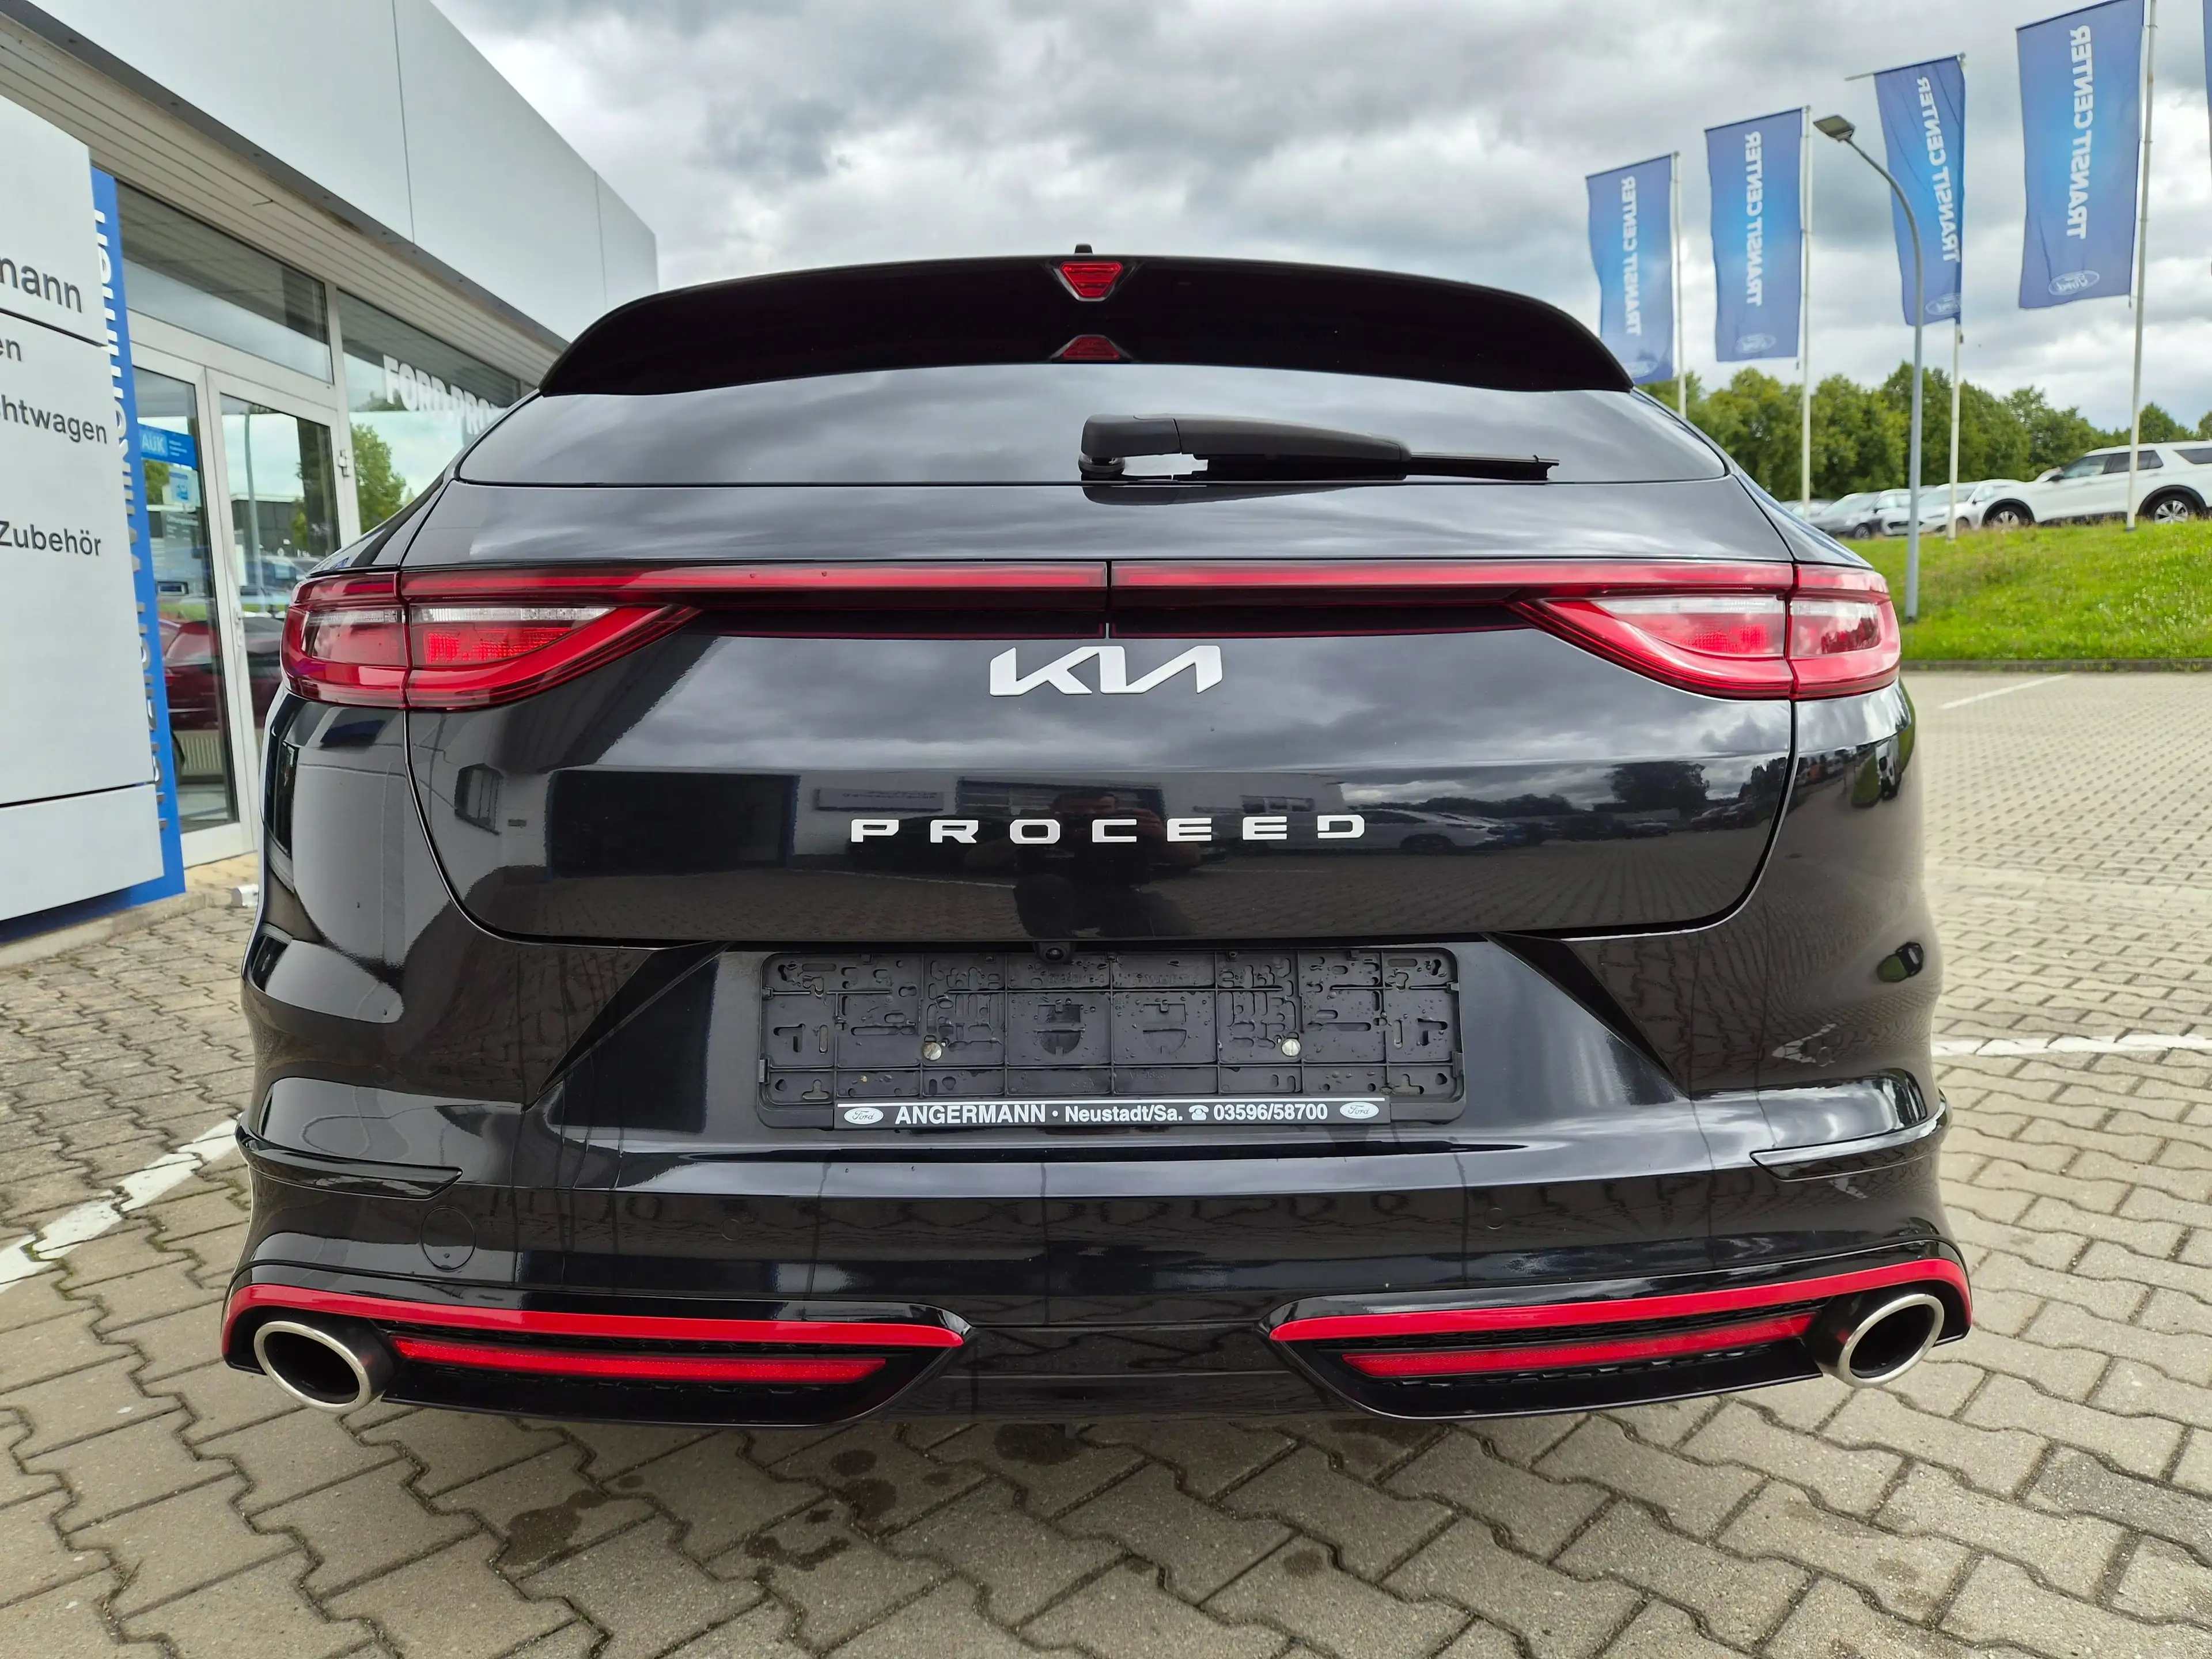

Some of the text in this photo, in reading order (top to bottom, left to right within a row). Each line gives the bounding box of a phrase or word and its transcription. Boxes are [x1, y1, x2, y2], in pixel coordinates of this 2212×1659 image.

[383, 354, 450, 421] FORD
[0, 394, 108, 444] htwagen
[0, 520, 101, 557] Zubehör
[990, 645, 1223, 696] KIA
[850, 814, 1366, 844] PROCEED
[852, 1103, 1370, 1125] Ford ANGERMANN Neustadt/Sa. 03596/58700 Ford
